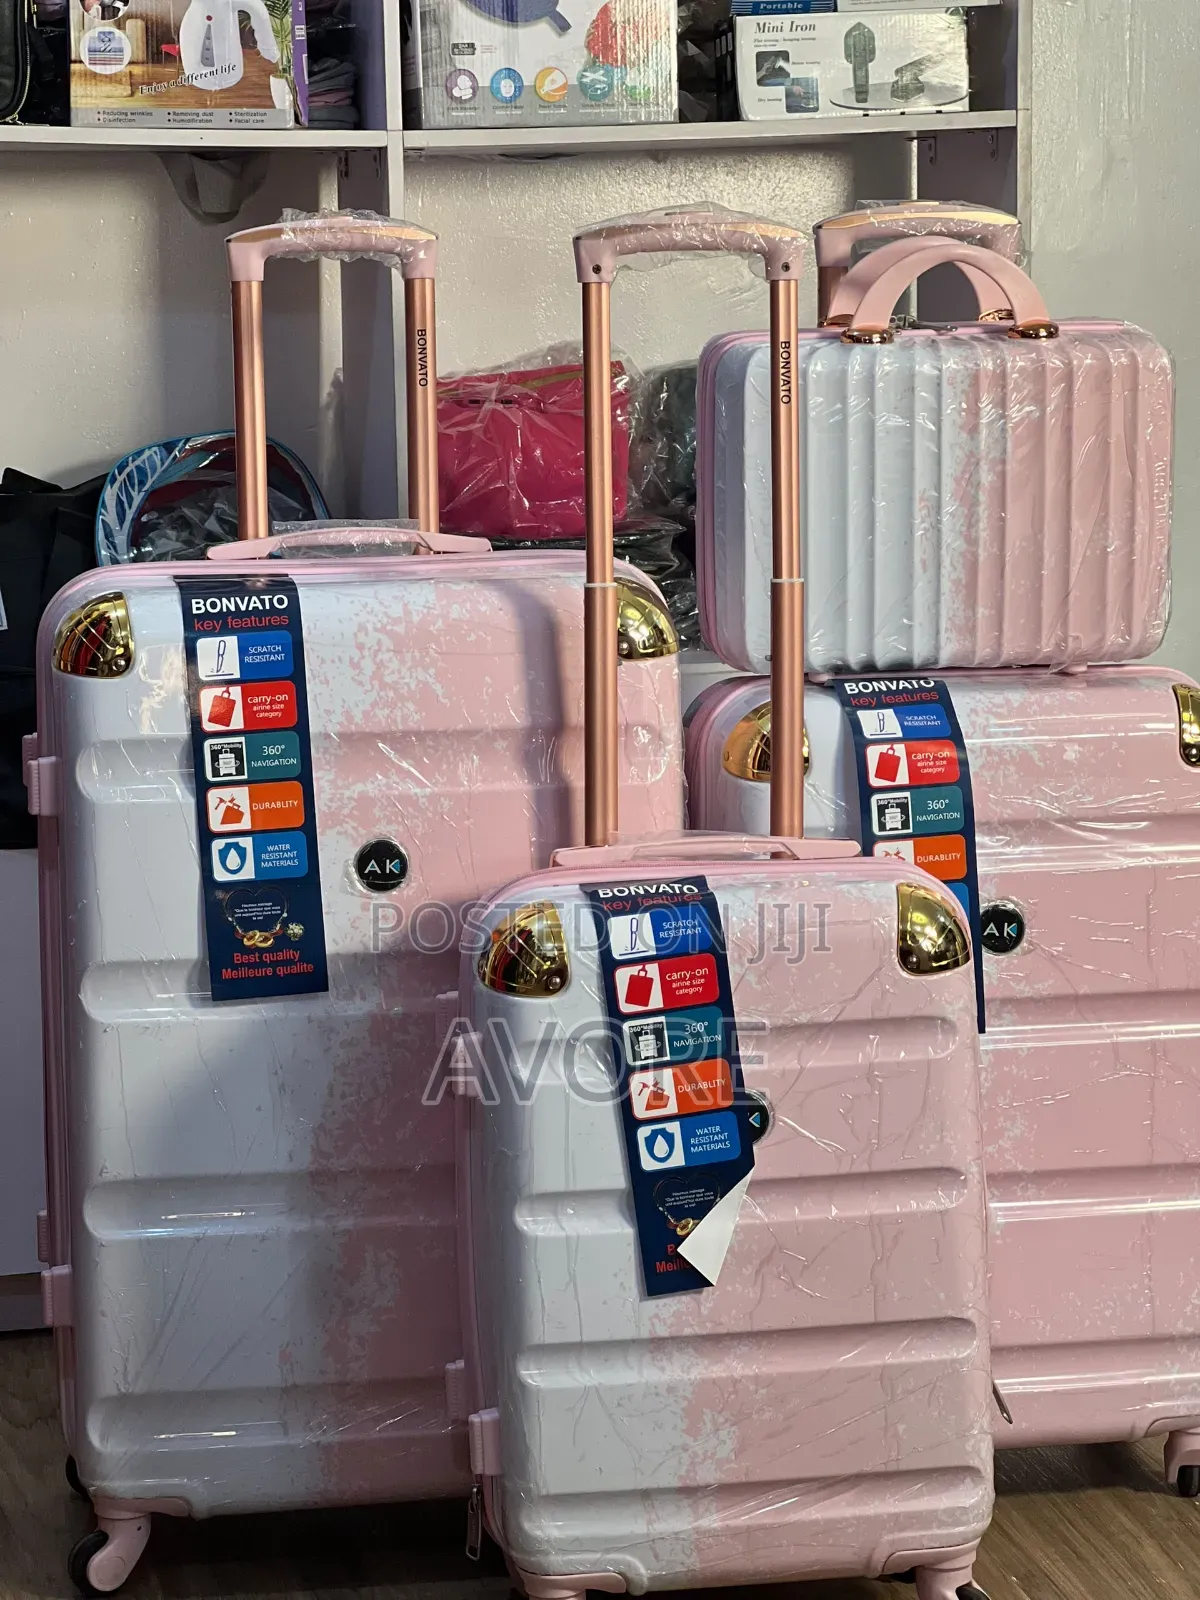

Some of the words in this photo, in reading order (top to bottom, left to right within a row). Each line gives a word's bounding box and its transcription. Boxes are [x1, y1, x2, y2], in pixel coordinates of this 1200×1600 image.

[760, 2, 803, 10] Portable
[754, 22, 784, 34] Mini
[789, 21, 816, 33] Iron
[139, 82, 168, 95] Enjoy
[177, 68, 218, 86] different
[220, 62, 237, 75] life
[417, 328, 428, 387] BONVATO
[780, 340, 792, 405] BONVATO
[191, 594, 289, 615] BONVATO
[194, 618, 222, 633] key
[226, 614, 290, 629] features
[248, 644, 282, 654] SCRATCH
[843, 679, 935, 695] BONVATO
[247, 693, 289, 705] carry-on
[850, 696, 877, 708] key
[881, 690, 940, 705] features
[255, 711, 282, 719] category
[262, 744, 286, 756] 360°
[251, 757, 297, 768] NAVIGATION
[911, 750, 951, 763] carry-on
[935, 758, 947, 766] size
[920, 766, 945, 775] category
[252, 800, 299, 811] DURABLITY
[927, 798, 950, 810] 360°
[916, 811, 961, 822] NAVIGATION
[266, 843, 291, 852] WATER
[261, 851, 298, 860] RESISTANT
[916, 852, 961, 863] DURABLITY
[261, 859, 299, 868] MATERIALS
[598, 883, 699, 899] BONVATO
[602, 899, 632, 912] key
[637, 893, 704, 907] features
[662, 919, 698, 929] SCRATCH
[233, 951, 260, 964] Best
[262, 948, 300, 965] quality
[221, 965, 273, 980] Meilleure
[276, 961, 314, 978] qualite
[665, 966, 709, 981] carry-on
[692, 976, 706, 986] size
[675, 985, 703, 996] category
[684, 1021, 709, 1035] 360°
[673, 1034, 722, 1048] NAVIGATION
[677, 1078, 726, 1093] DURABLITY
[695, 1125, 722, 1136] WATER
[690, 1132, 729, 1145] RESISTANT
[690, 1140, 731, 1154] MATERIALS
